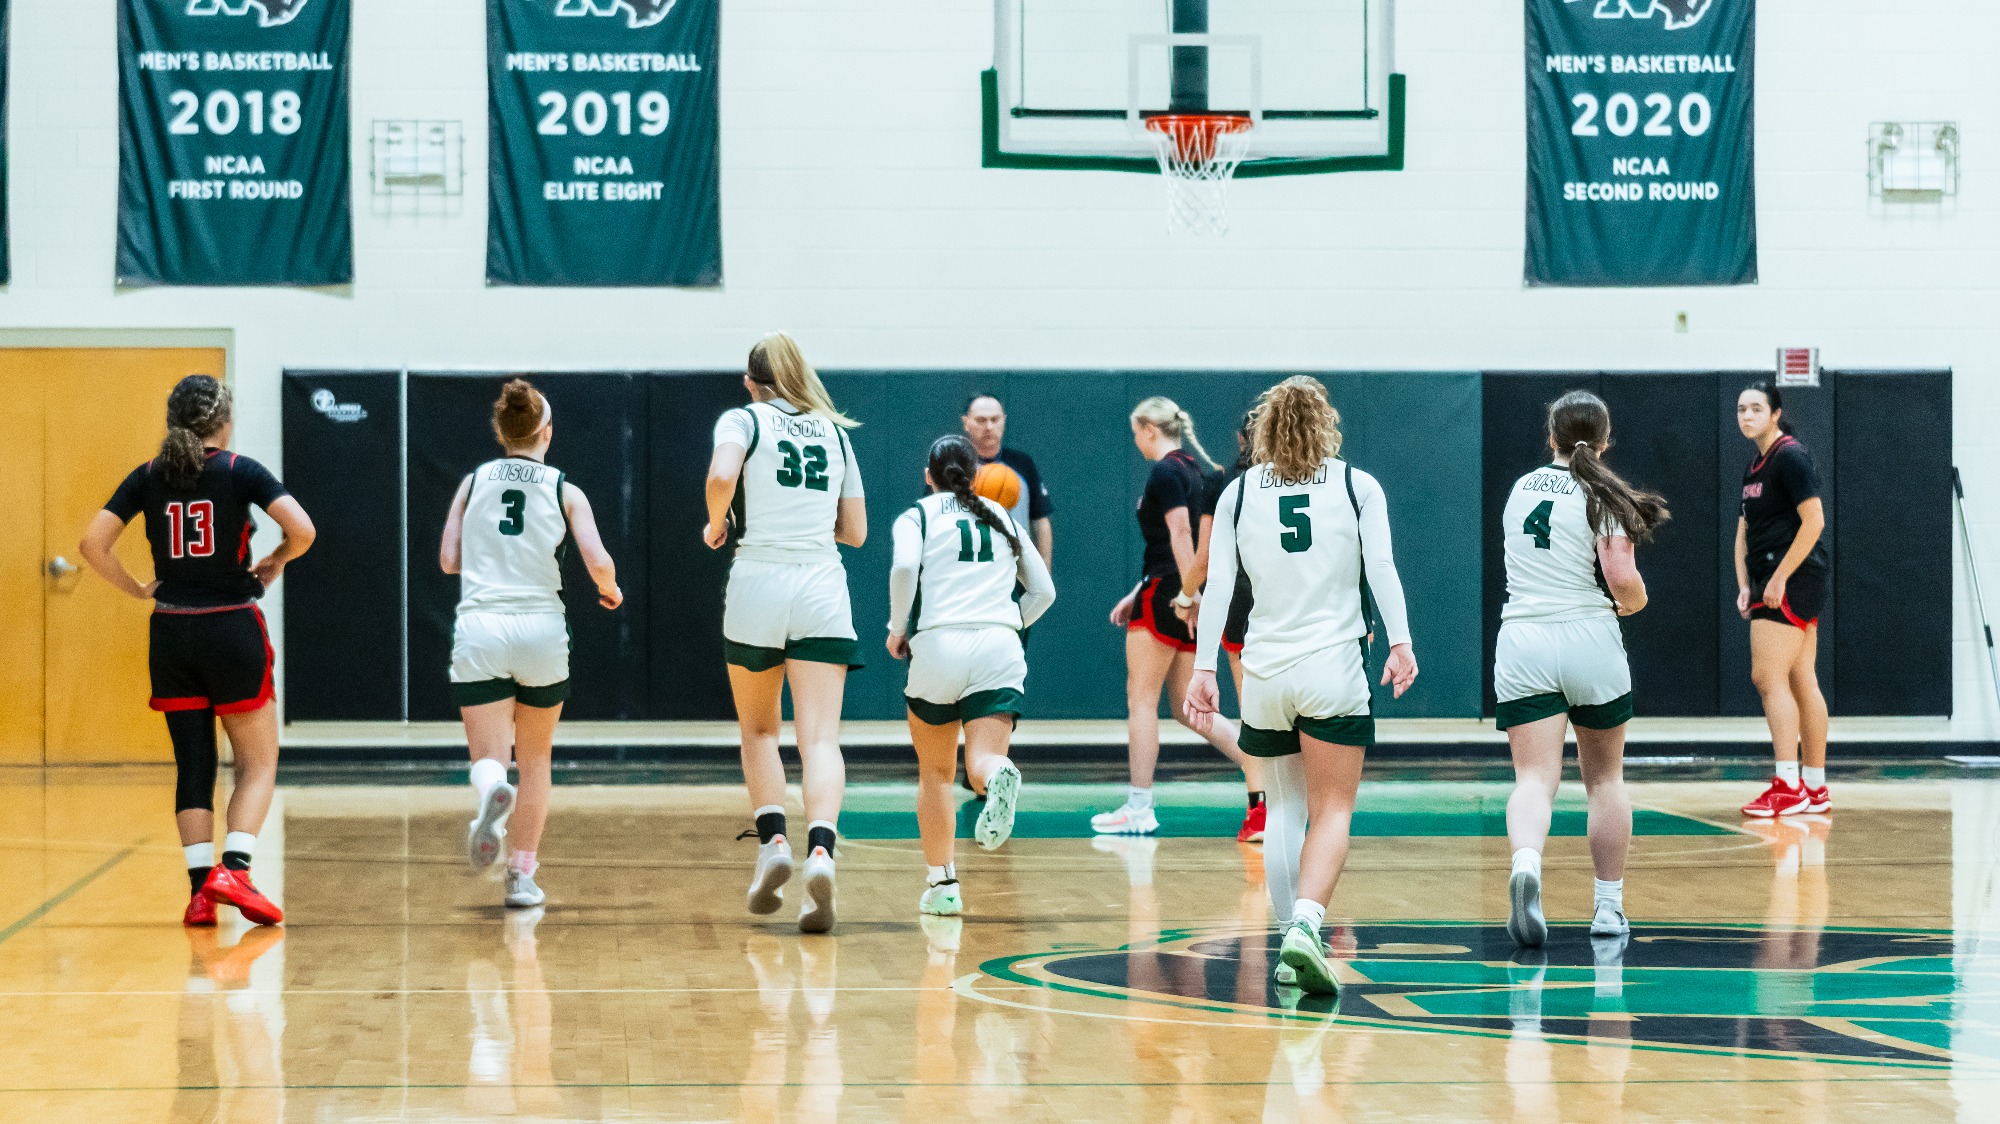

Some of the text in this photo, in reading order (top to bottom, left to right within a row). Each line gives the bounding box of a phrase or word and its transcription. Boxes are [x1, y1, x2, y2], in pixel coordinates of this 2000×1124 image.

[204, 52, 333, 71] BASKETBALL
[572, 53, 702, 72] BASKETBALL
[1611, 55, 1736, 73] BASKETBALL
[168, 89, 302, 135] 2018
[537, 90, 670, 136] 2019
[1571, 92, 1711, 137] 2020
[204, 155, 266, 175] NCAA
[573, 156, 634, 175] NCAA
[1612, 157, 1670, 176] NCAA
[168, 180, 304, 199] FIRST ROUND
[543, 181, 664, 201] ELITE EIGHT
[1563, 181, 1719, 201] SECOND ROUND
[772, 414, 826, 438] BISON
[488, 463, 547, 484] BISON
[776, 440, 830, 492] 32
[1523, 473, 1580, 495] BISON
[498, 489, 527, 536] 3
[1278, 493, 1313, 553] 5
[165, 500, 216, 558] 13
[1522, 499, 1555, 551] 4
[955, 518, 995, 563] 11
